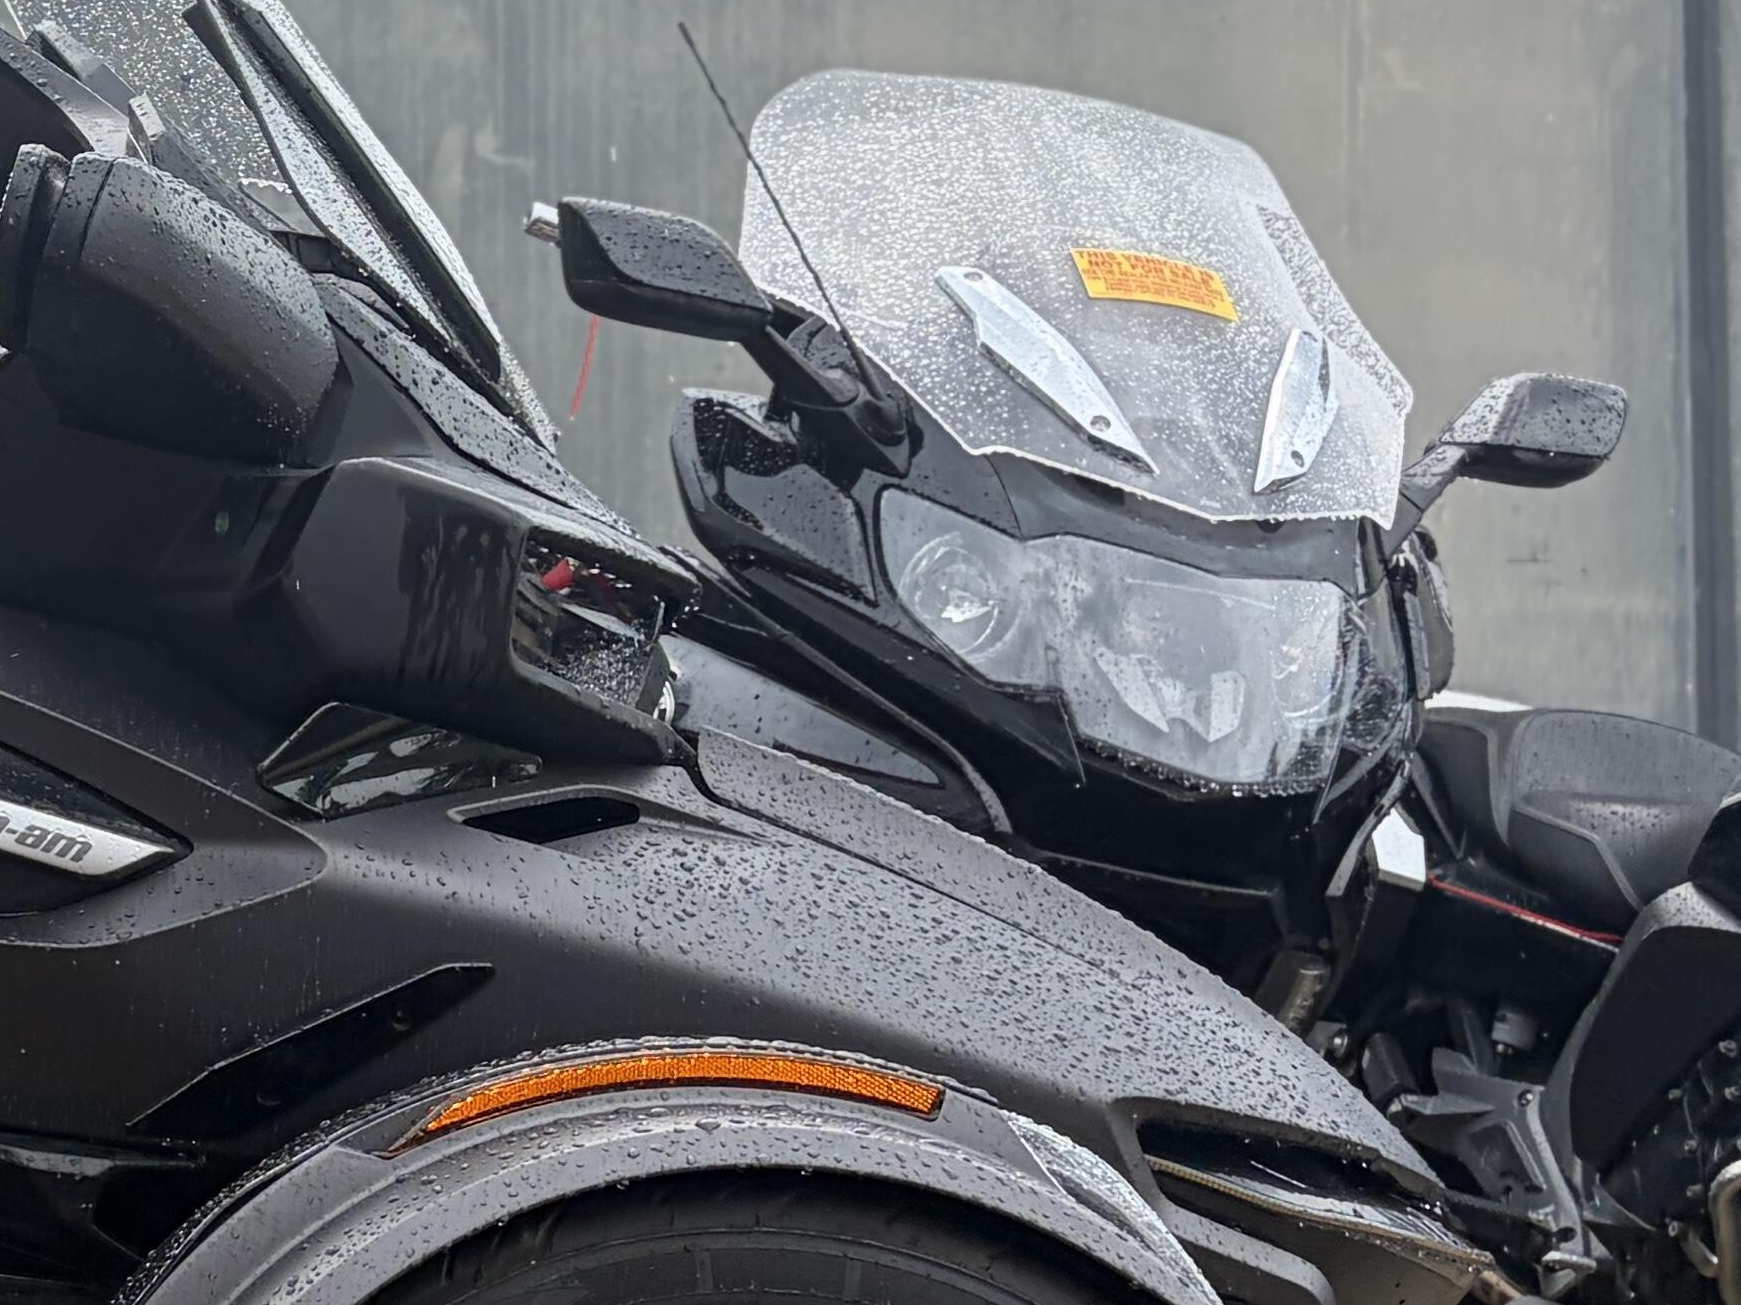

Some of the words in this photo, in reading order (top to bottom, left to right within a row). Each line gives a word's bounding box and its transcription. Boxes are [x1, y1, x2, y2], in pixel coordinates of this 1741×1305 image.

[1075, 250, 1117, 261] THIS
[1124, 253, 1192, 272] VEHICLE
[1088, 259, 1122, 270] NOT
[1130, 263, 1164, 275] FOR
